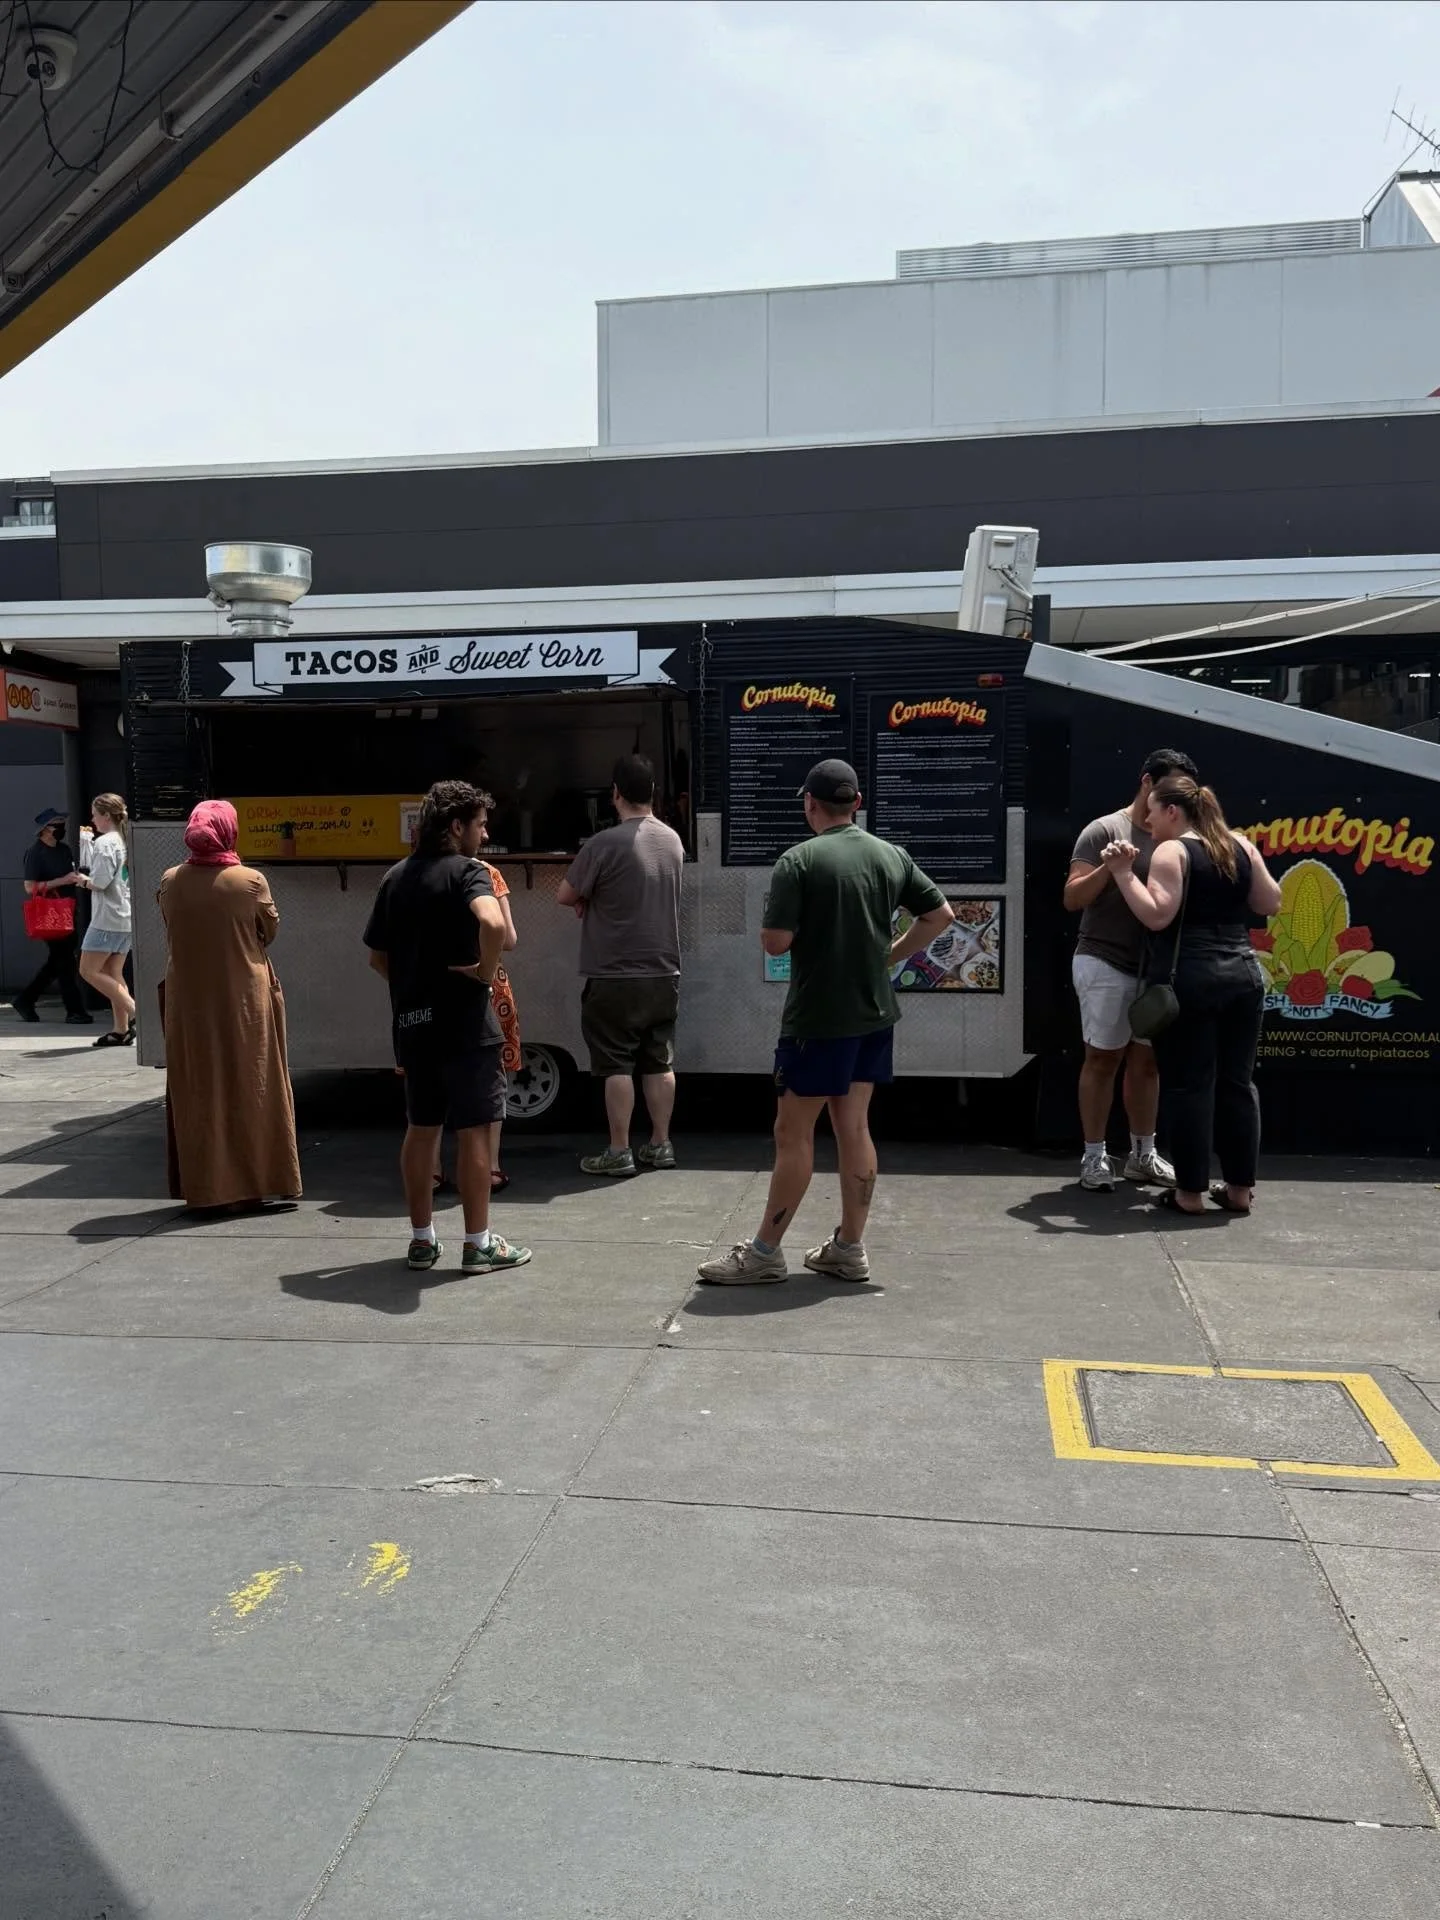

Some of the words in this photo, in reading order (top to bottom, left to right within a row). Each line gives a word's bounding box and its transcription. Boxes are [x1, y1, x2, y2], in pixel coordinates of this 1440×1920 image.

[285, 649, 398, 676] TACOS
[407, 648, 440, 671] AND
[445, 641, 533, 674] Sweet
[540, 640, 604, 668] Corn
[740, 682, 837, 711] Cornutopia
[888, 697, 987, 727] Cornutopia
[1233, 807, 1435, 875] rnutopia
[399, 1008, 433, 1029] SUPREME
[1292, 1006, 1322, 1018] NOT
[1329, 995, 1381, 1017] FANCY
[1257, 1046, 1296, 1057] ERING
[1310, 1046, 1430, 1061] @cornutopiatacos
